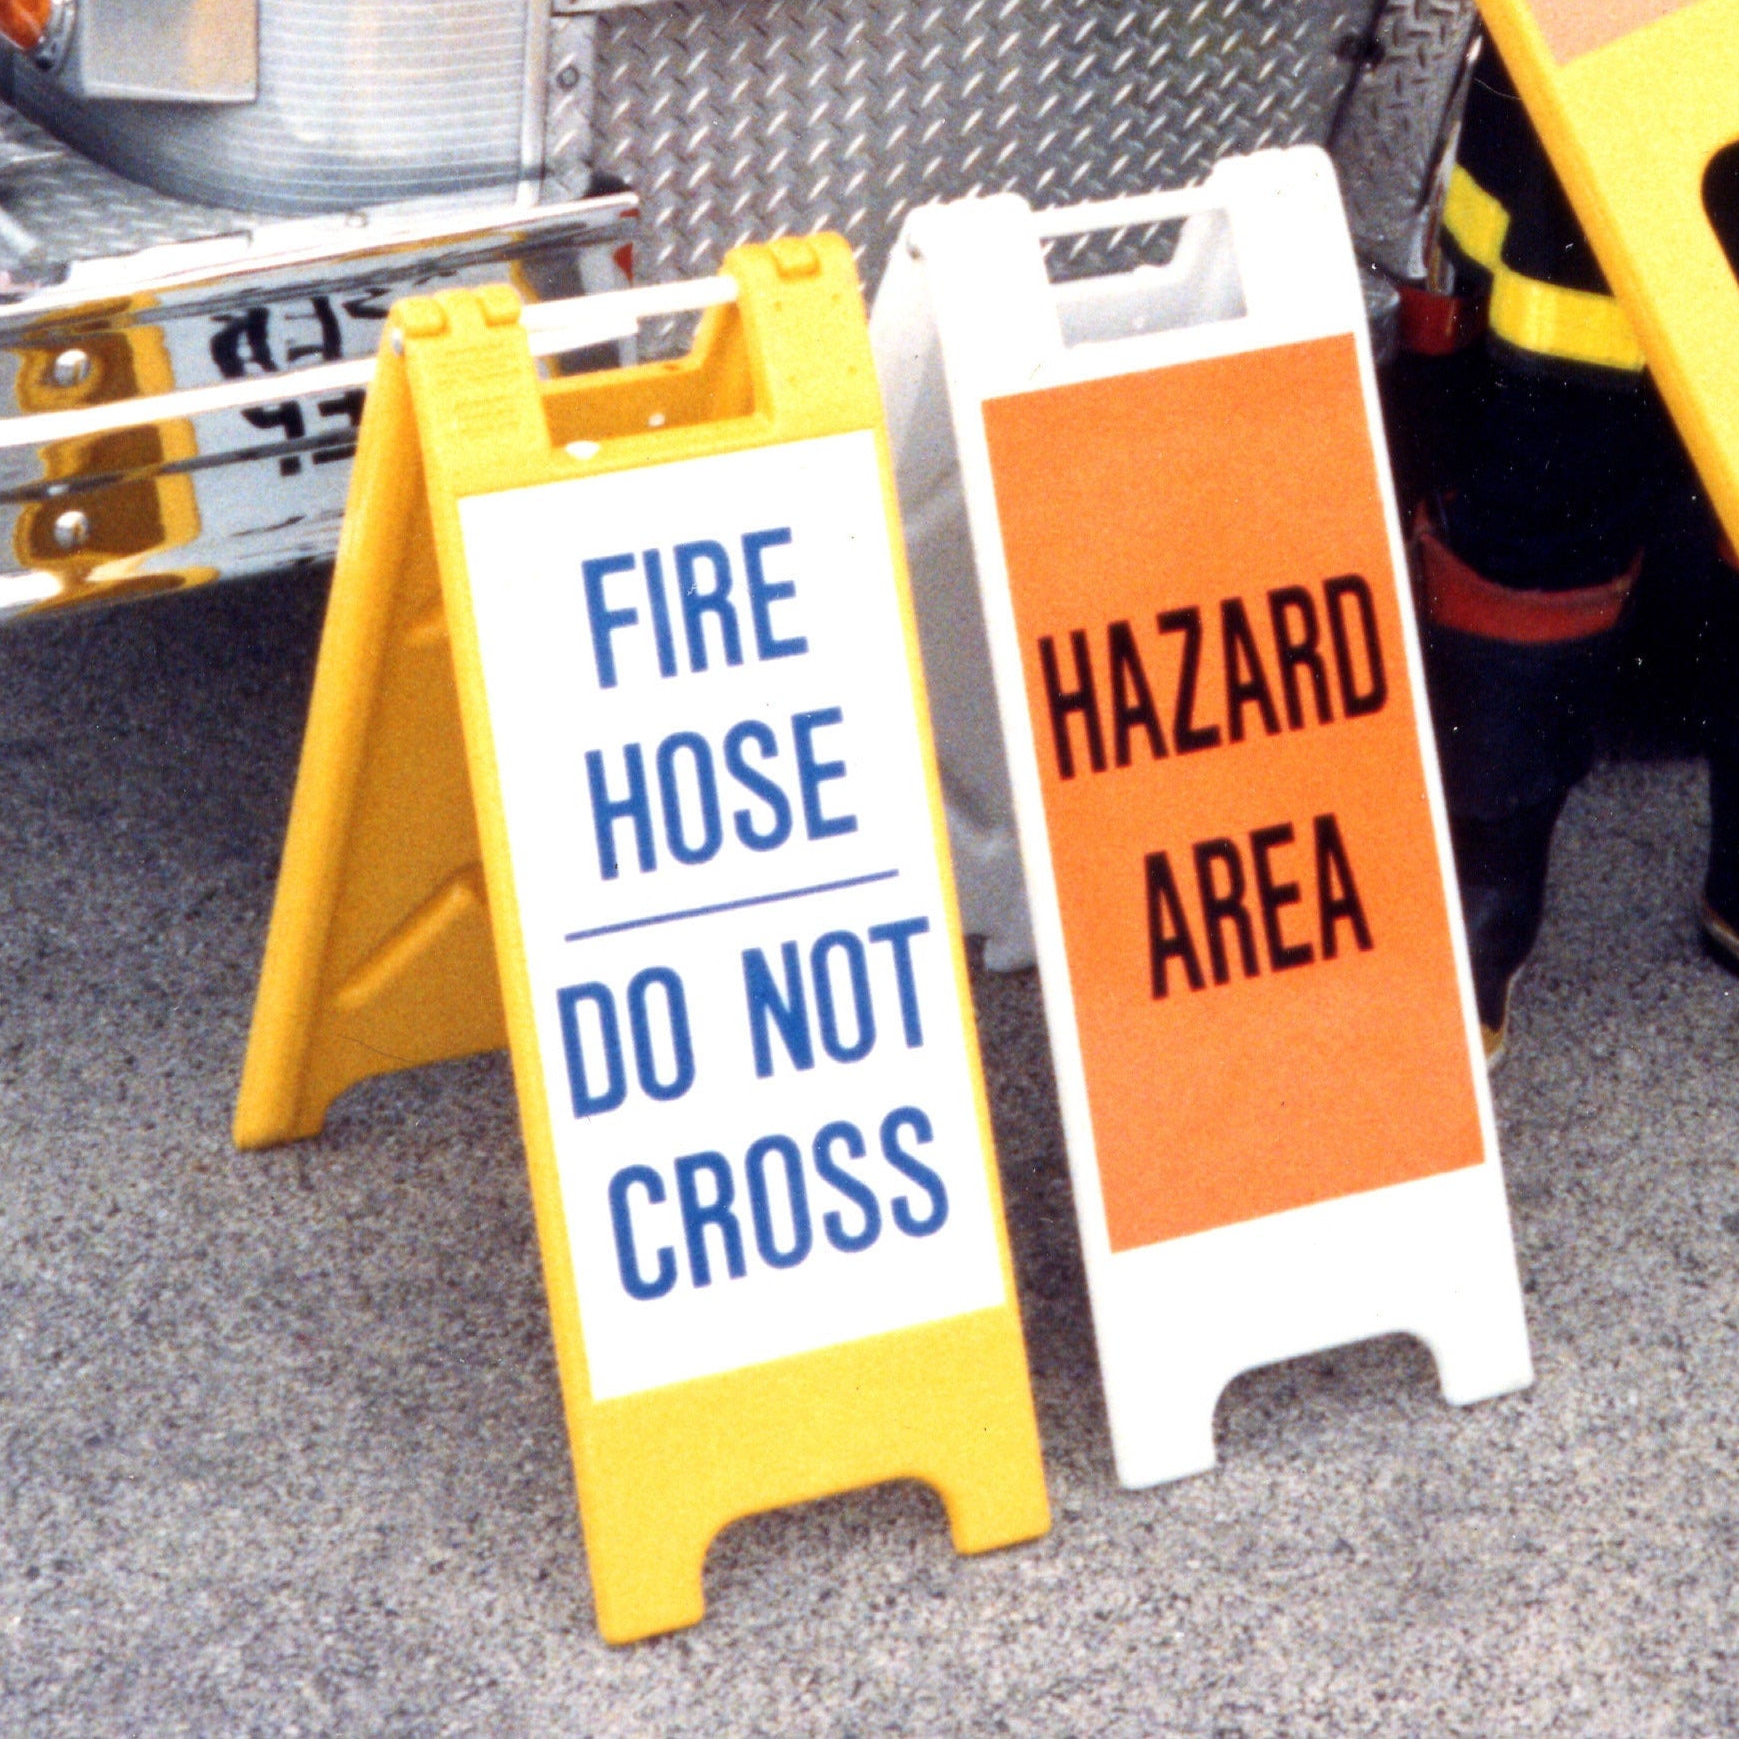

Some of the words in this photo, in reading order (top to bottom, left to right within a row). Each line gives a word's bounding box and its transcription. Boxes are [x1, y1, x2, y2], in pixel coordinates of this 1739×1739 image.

[582, 526, 809, 689] FIRE
[1037, 573, 1388, 781] HAZARD
[584, 706, 859, 882] HOSE
[1144, 812, 1374, 1001] AREA
[555, 965, 697, 1120] DO
[741, 916, 930, 1079] NOT
[607, 1105, 951, 1303] CROSS
